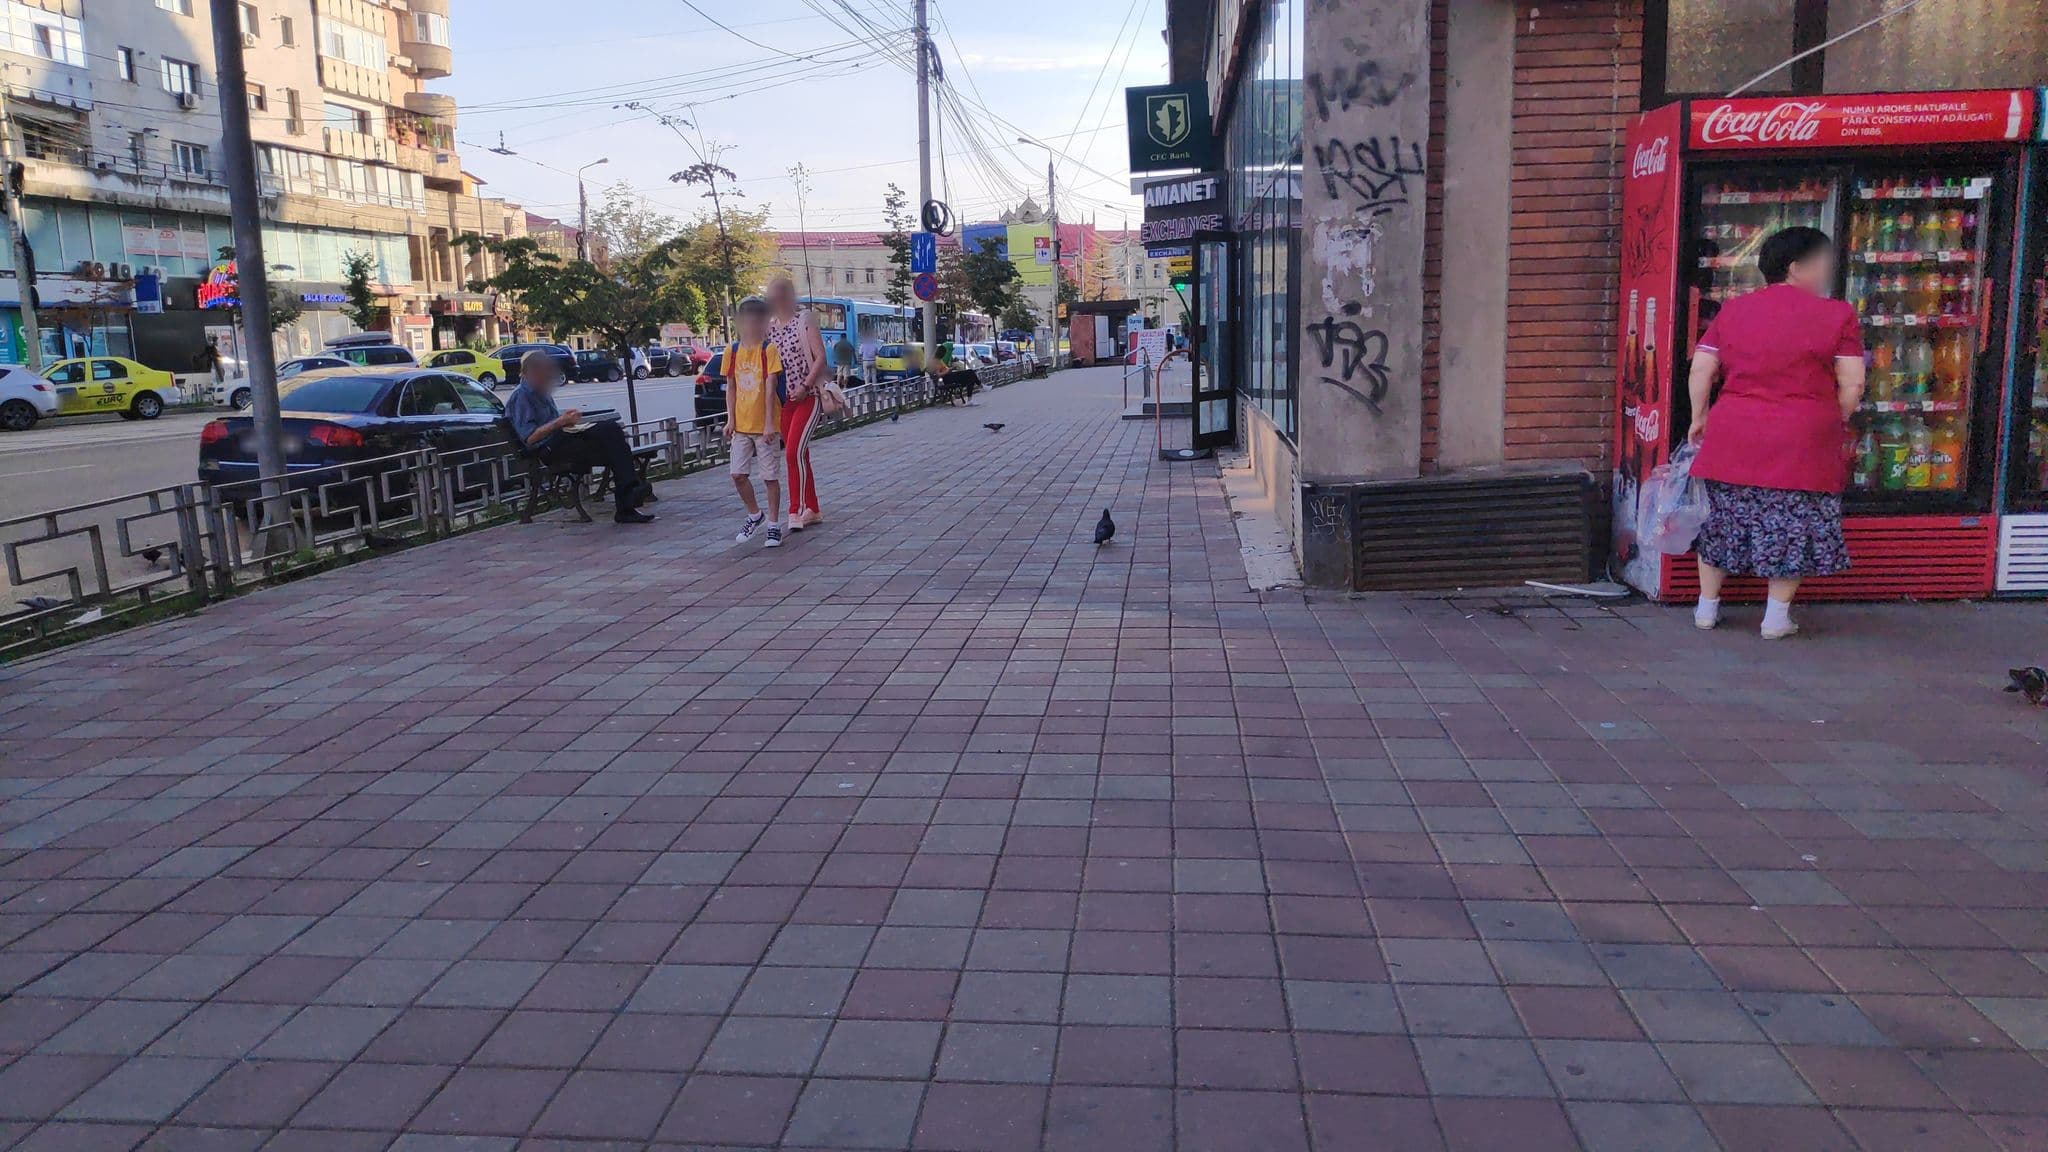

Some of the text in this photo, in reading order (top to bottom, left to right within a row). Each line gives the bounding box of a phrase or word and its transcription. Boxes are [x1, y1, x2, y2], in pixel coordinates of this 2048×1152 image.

[1842, 105, 1875, 114] NUMAI
[1877, 104, 1912, 113] AROME
[1702, 102, 1827, 143] Coca-Cola
[1841, 128, 1859, 136] DIN
[1169, 151, 1190, 160] Bank
[1144, 178, 1215, 208] AMANET
[1141, 214, 1220, 243] EXCHANGE
